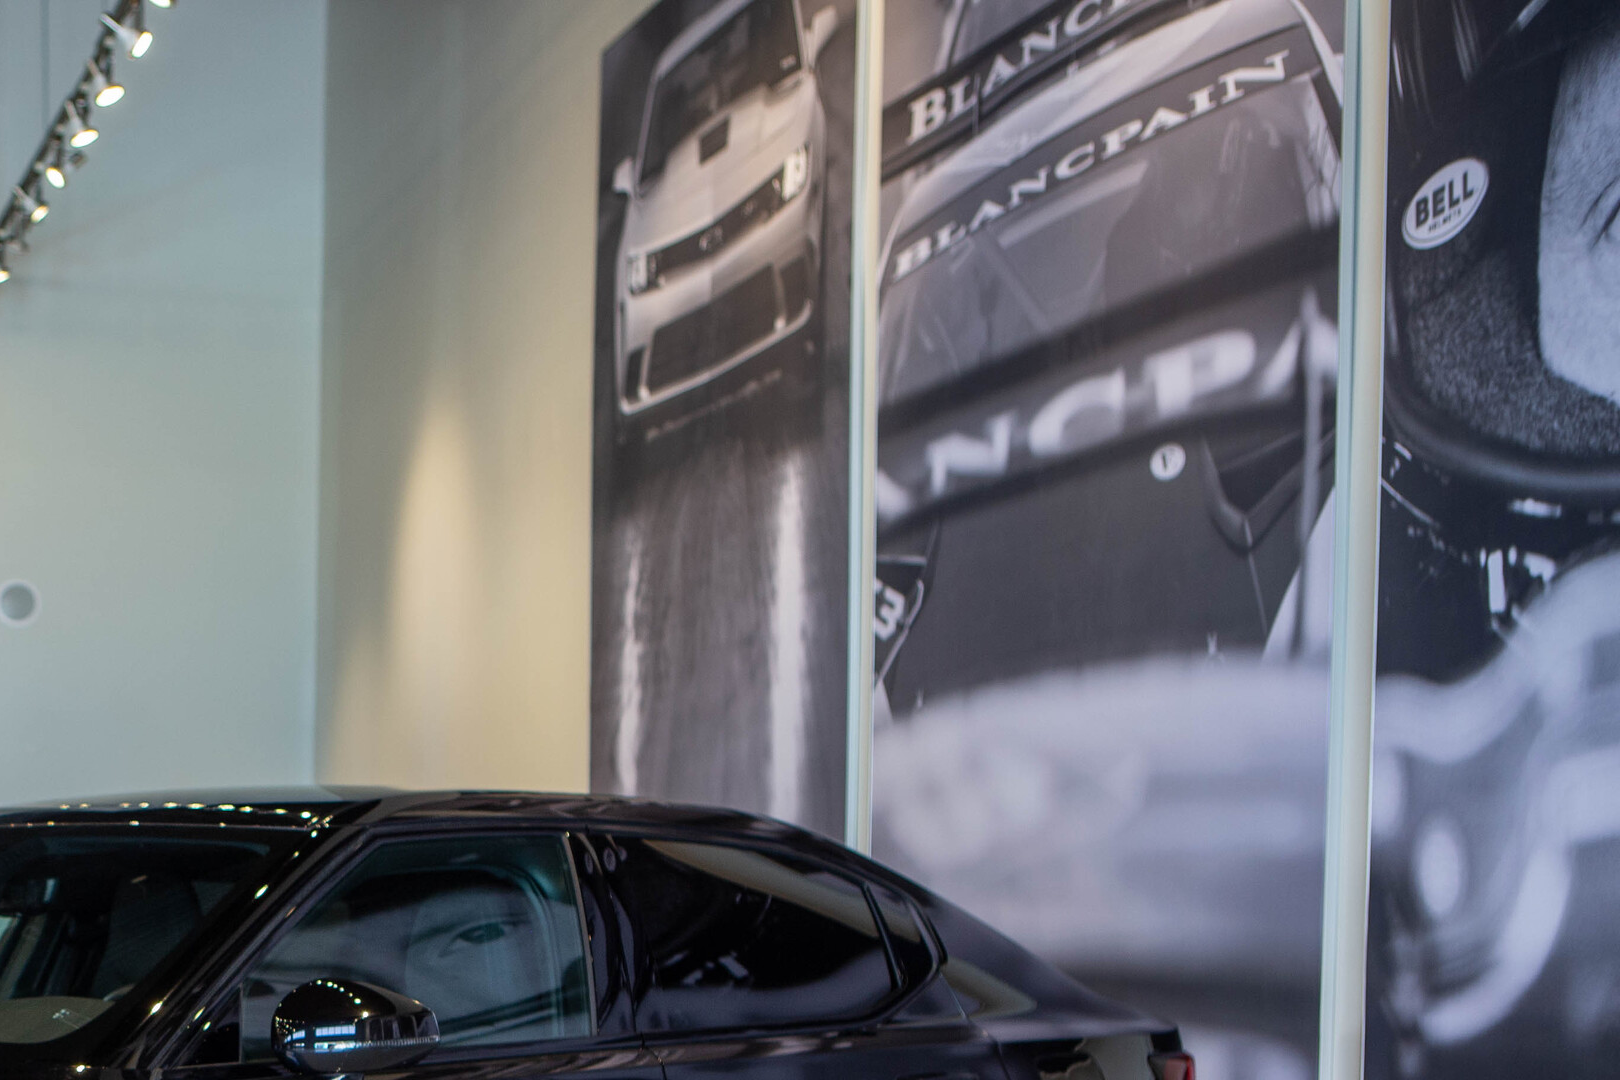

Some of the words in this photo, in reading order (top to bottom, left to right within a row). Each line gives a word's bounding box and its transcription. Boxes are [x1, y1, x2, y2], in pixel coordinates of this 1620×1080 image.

[905, 0, 1131, 147] BLANC
[892, 50, 1290, 284] BLANCPAIN
[1415, 170, 1475, 230] BELL
